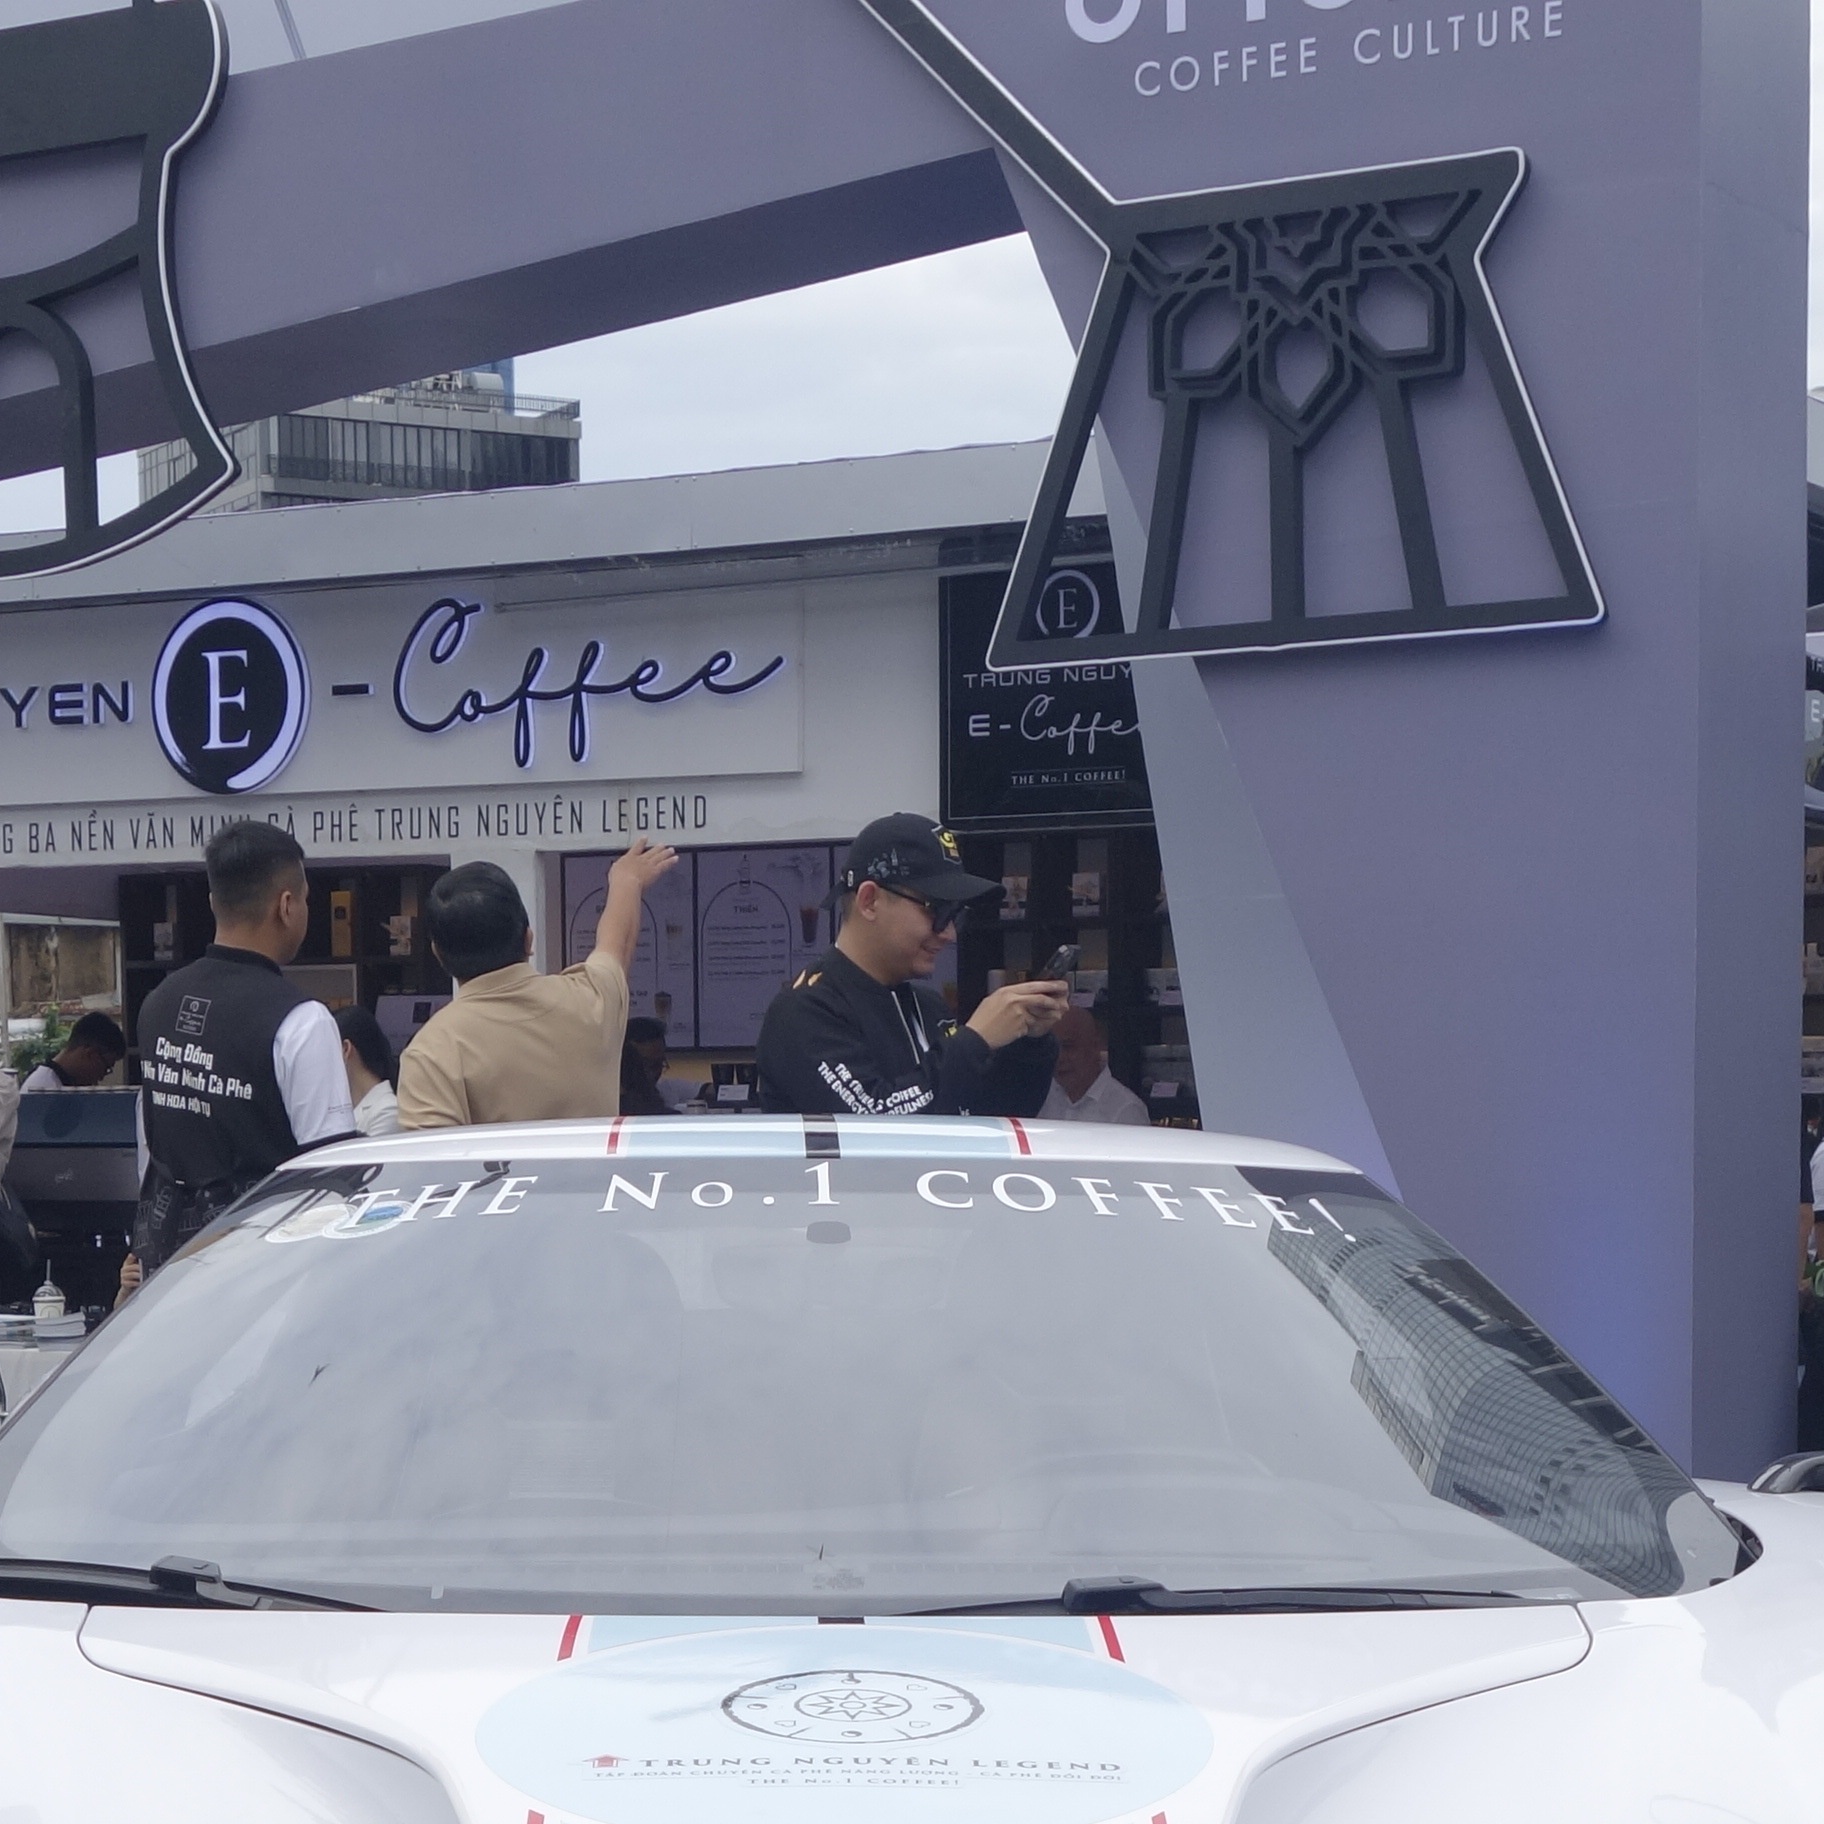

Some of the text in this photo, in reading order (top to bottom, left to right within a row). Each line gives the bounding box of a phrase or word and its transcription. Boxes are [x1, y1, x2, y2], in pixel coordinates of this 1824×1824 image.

[1133, 36, 1318, 97] COFFEE
[1353, 0, 1564, 64] CULTURE
[963, 668, 1051, 689] TRUNG
[1010, 773, 1036, 786] THE
[28, 819, 57, 854] BA
[71, 808, 115, 851] NỀN
[130, 810, 175, 850] VĂN
[312, 801, 359, 843] PHÊ
[375, 805, 461, 840] TRUNG
[477, 794, 584, 838] NGUYÊN
[600, 793, 708, 834] LEGEND
[340, 1160, 1358, 1244] THE No.1 COFFEE!
[638, 1755, 1124, 1772] TRUNG NGUYÊN LEGEND
[747, 1776, 791, 1785] THE
[867, 1776, 961, 1786] COFFEE!
